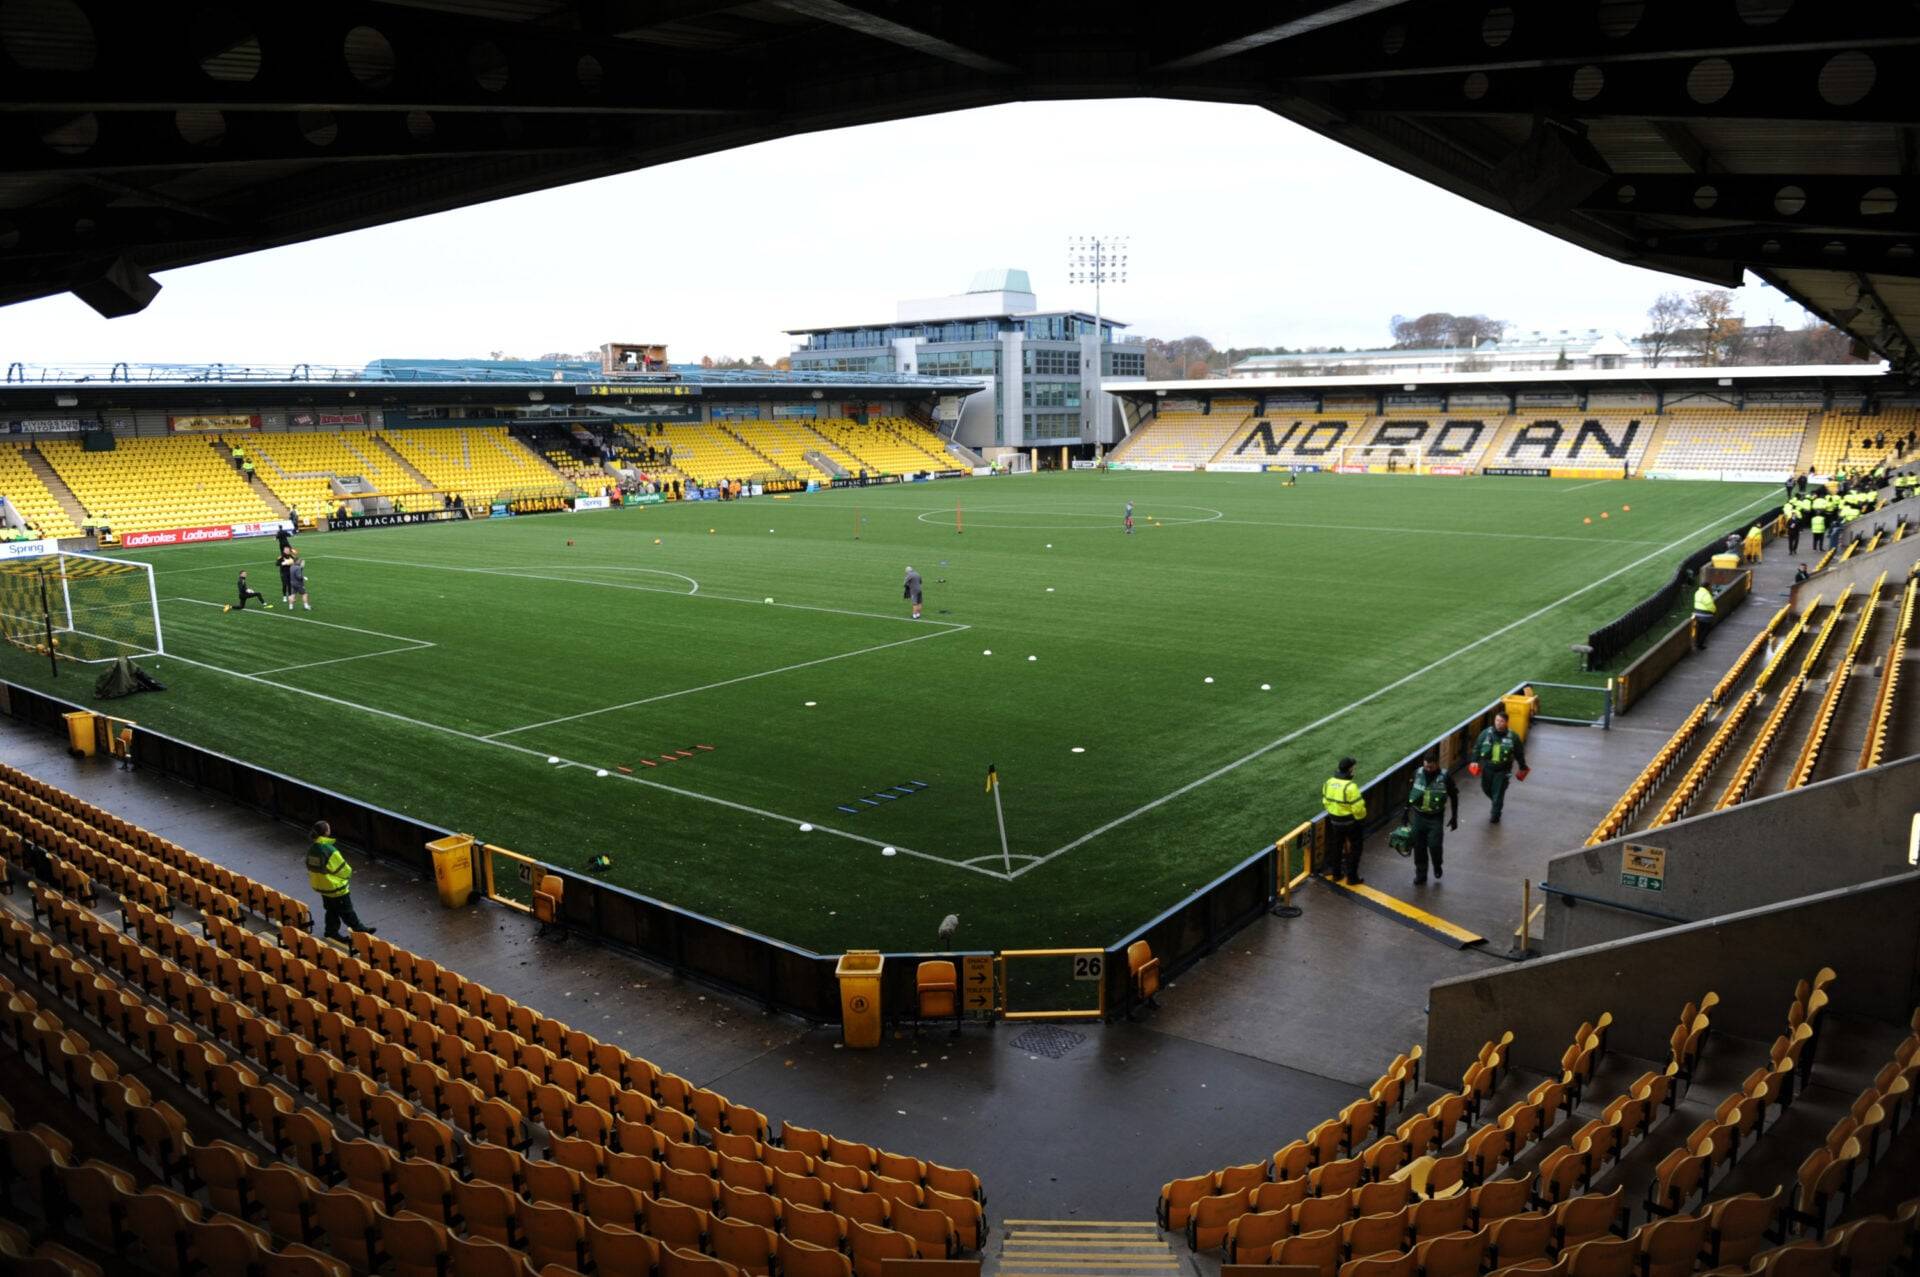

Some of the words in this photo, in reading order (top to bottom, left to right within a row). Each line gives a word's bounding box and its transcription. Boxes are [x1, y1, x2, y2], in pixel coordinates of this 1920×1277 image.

[22, 419, 79, 427] LIVINGSTON
[582, 497, 603, 508] Spring
[127, 530, 177, 546] Ladbrokes
[182, 527, 230, 540] Ladbrokes
[8, 543, 44, 555] Spring
[519, 863, 531, 882] 27
[1076, 957, 1101, 976] 26
